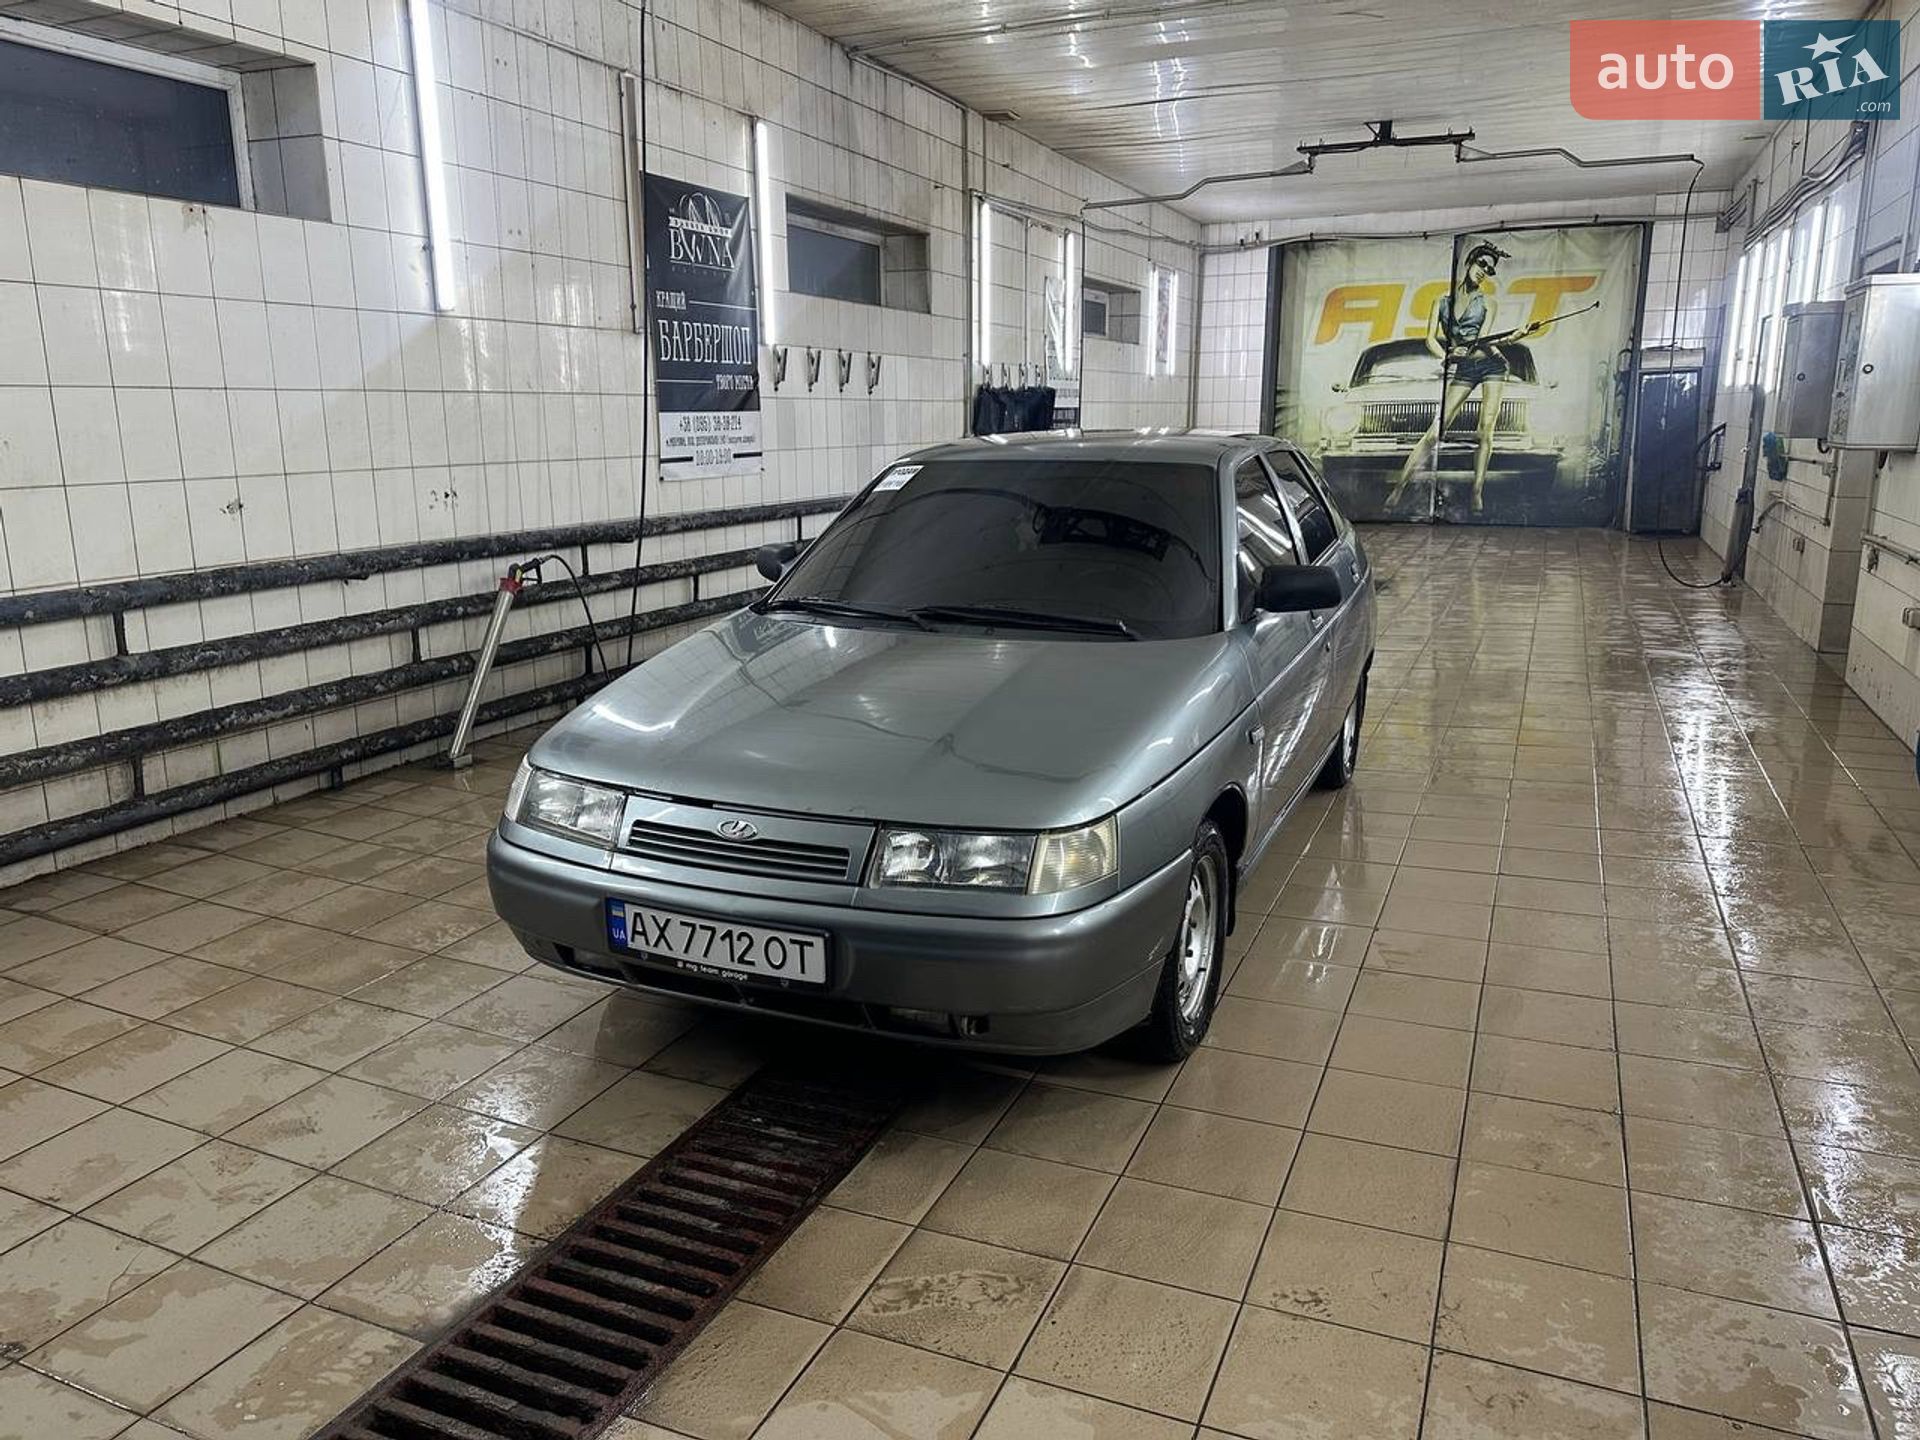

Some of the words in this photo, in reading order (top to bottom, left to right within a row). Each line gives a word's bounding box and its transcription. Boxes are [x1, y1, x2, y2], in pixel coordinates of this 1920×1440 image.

[655, 290, 687, 312] КРАЩИЙ
[658, 319, 752, 365] БАРБЕРШОП
[612, 927, 626, 941] UA
[630, 912, 673, 951] AX
[680, 921, 756, 967] 7712
[763, 936, 814, 974] OT
[721, 970, 748, 981] garage
